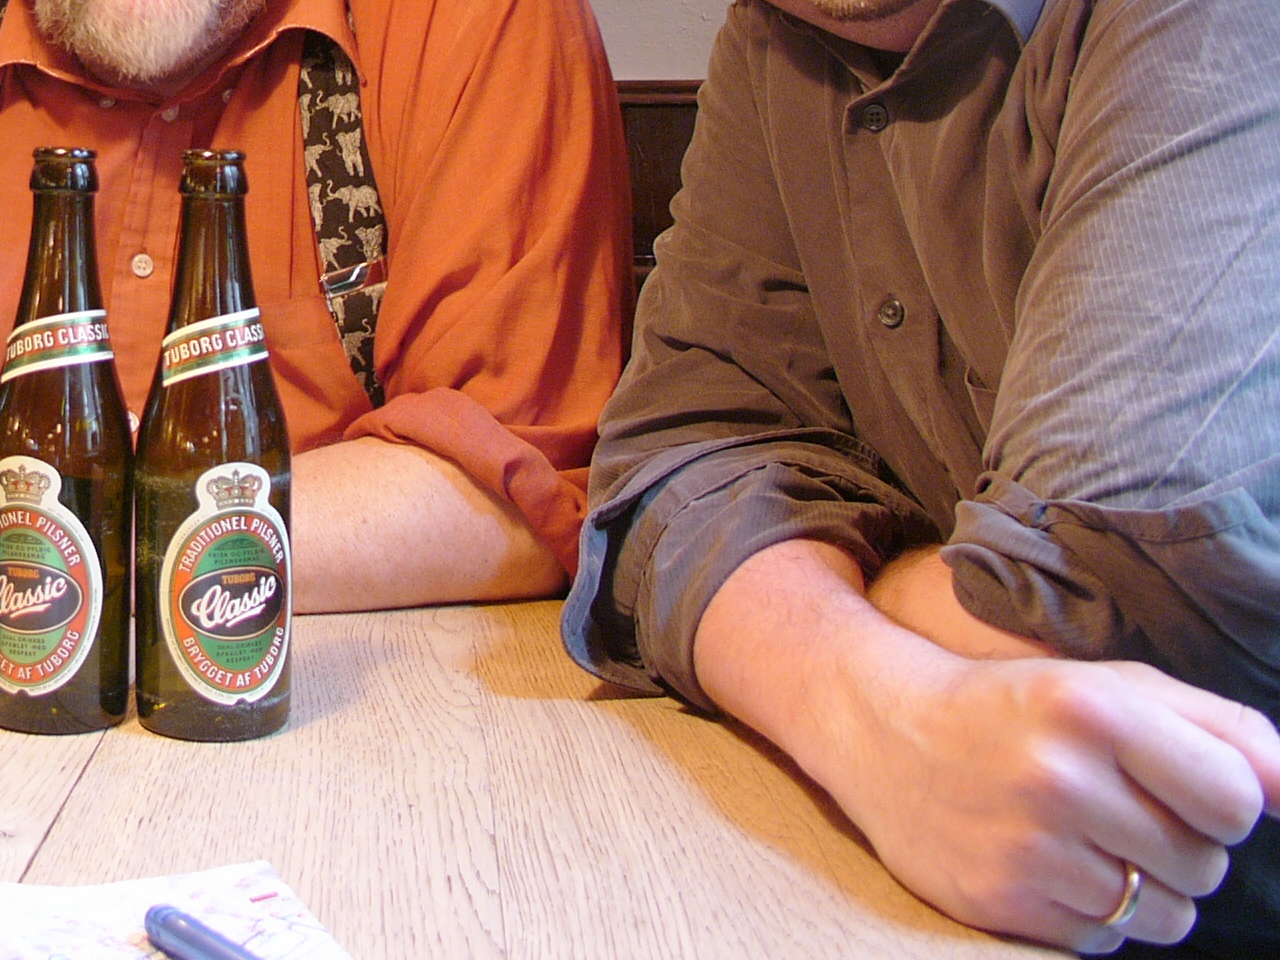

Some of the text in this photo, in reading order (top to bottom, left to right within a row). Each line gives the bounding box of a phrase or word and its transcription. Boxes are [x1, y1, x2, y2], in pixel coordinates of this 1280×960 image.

[5, 331, 54, 361] TUBORG
[164, 323, 266, 366] TUBORG CLASS
[36, 516, 81, 566] PILSNER
[179, 515, 248, 572] TRADITIONEL
[250, 518, 284, 564] PILSNER
[191, 574, 277, 628] Classic
[221, 572, 256, 585] TUBORG
[17, 666, 32, 680] AF
[36, 629, 80, 676] TUBORG
[183, 636, 233, 686] BRYGGET
[236, 671, 252, 687] AF
[253, 626, 284, 680] TUBORG
